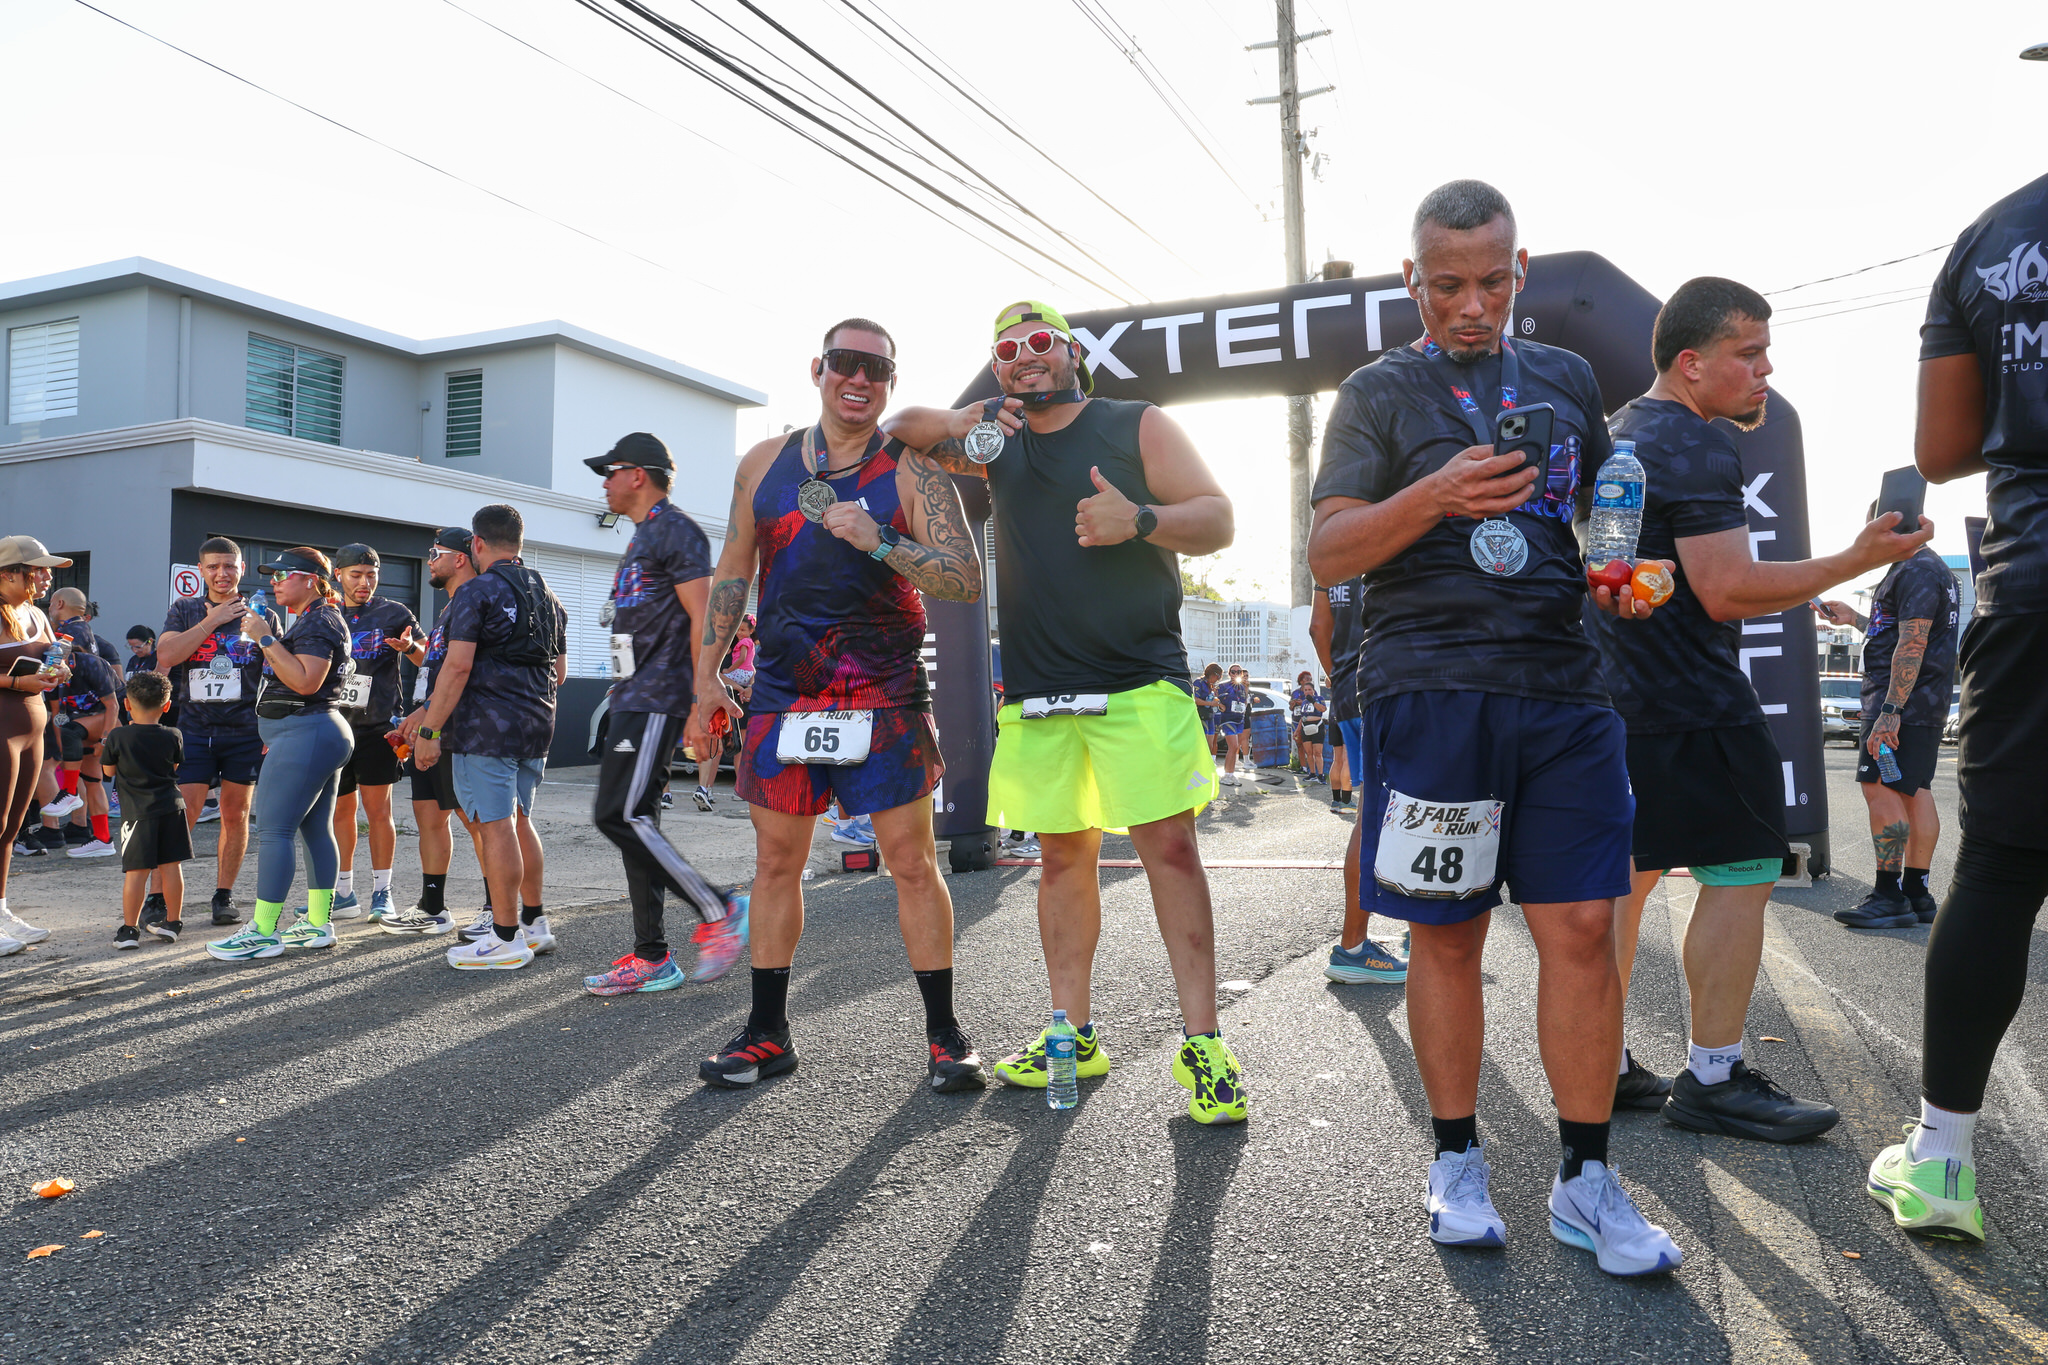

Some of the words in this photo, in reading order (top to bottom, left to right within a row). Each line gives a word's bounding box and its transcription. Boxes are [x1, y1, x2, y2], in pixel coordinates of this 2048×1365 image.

[2002, 361, 2044, 374] STUD
[1489, 521, 1505, 530] 5K
[182, 575, 193, 594] E
[186, 653, 215, 662] ADE
[204, 683, 225, 697] 17
[826, 709, 855, 721] RUN
[804, 726, 840, 753] 65
[1421, 806, 1471, 822] FADE
[1432, 822, 1445, 834] &
[1444, 821, 1480, 836] RUN
[1410, 845, 1464, 884] 48
[1728, 865, 1755, 873] Reebok
[1365, 957, 1394, 970] HOKA
